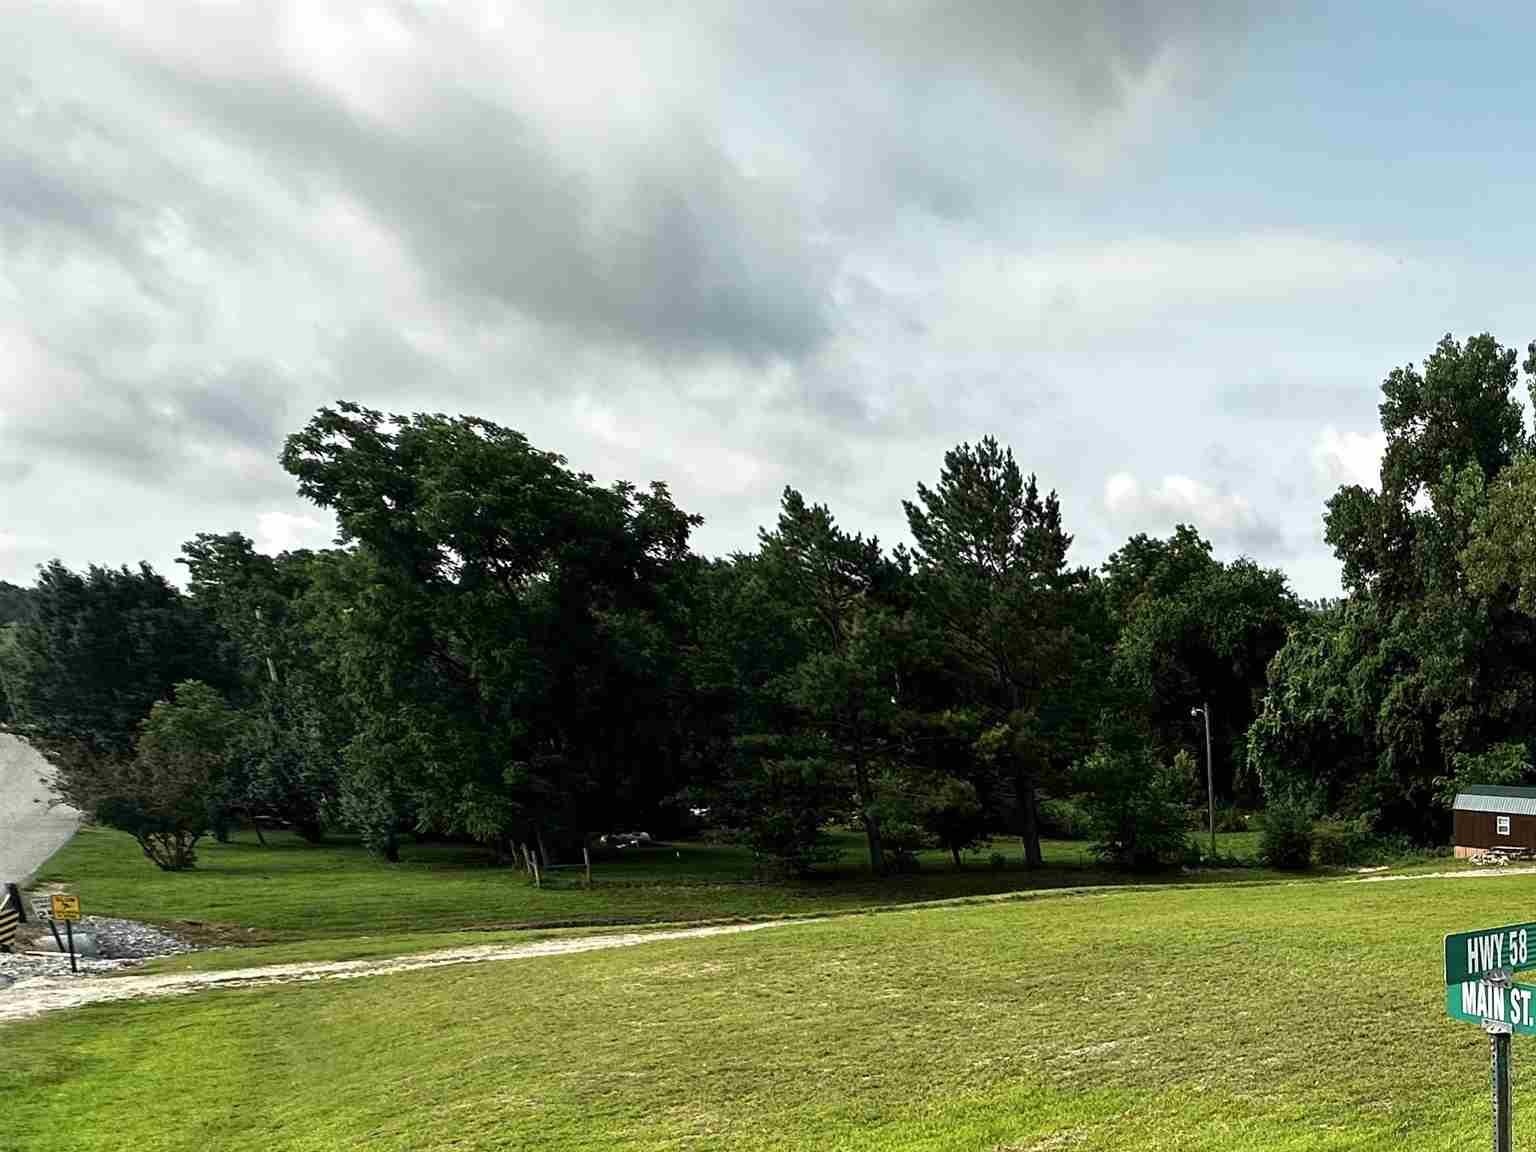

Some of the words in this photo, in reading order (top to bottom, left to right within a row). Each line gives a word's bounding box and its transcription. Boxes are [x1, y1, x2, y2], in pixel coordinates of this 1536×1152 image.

[1467, 932, 1505, 974] HWY
[1509, 929, 1527, 966] 58
[1462, 981, 1505, 1021] MAIN
[1510, 988, 1534, 1026] ST.
